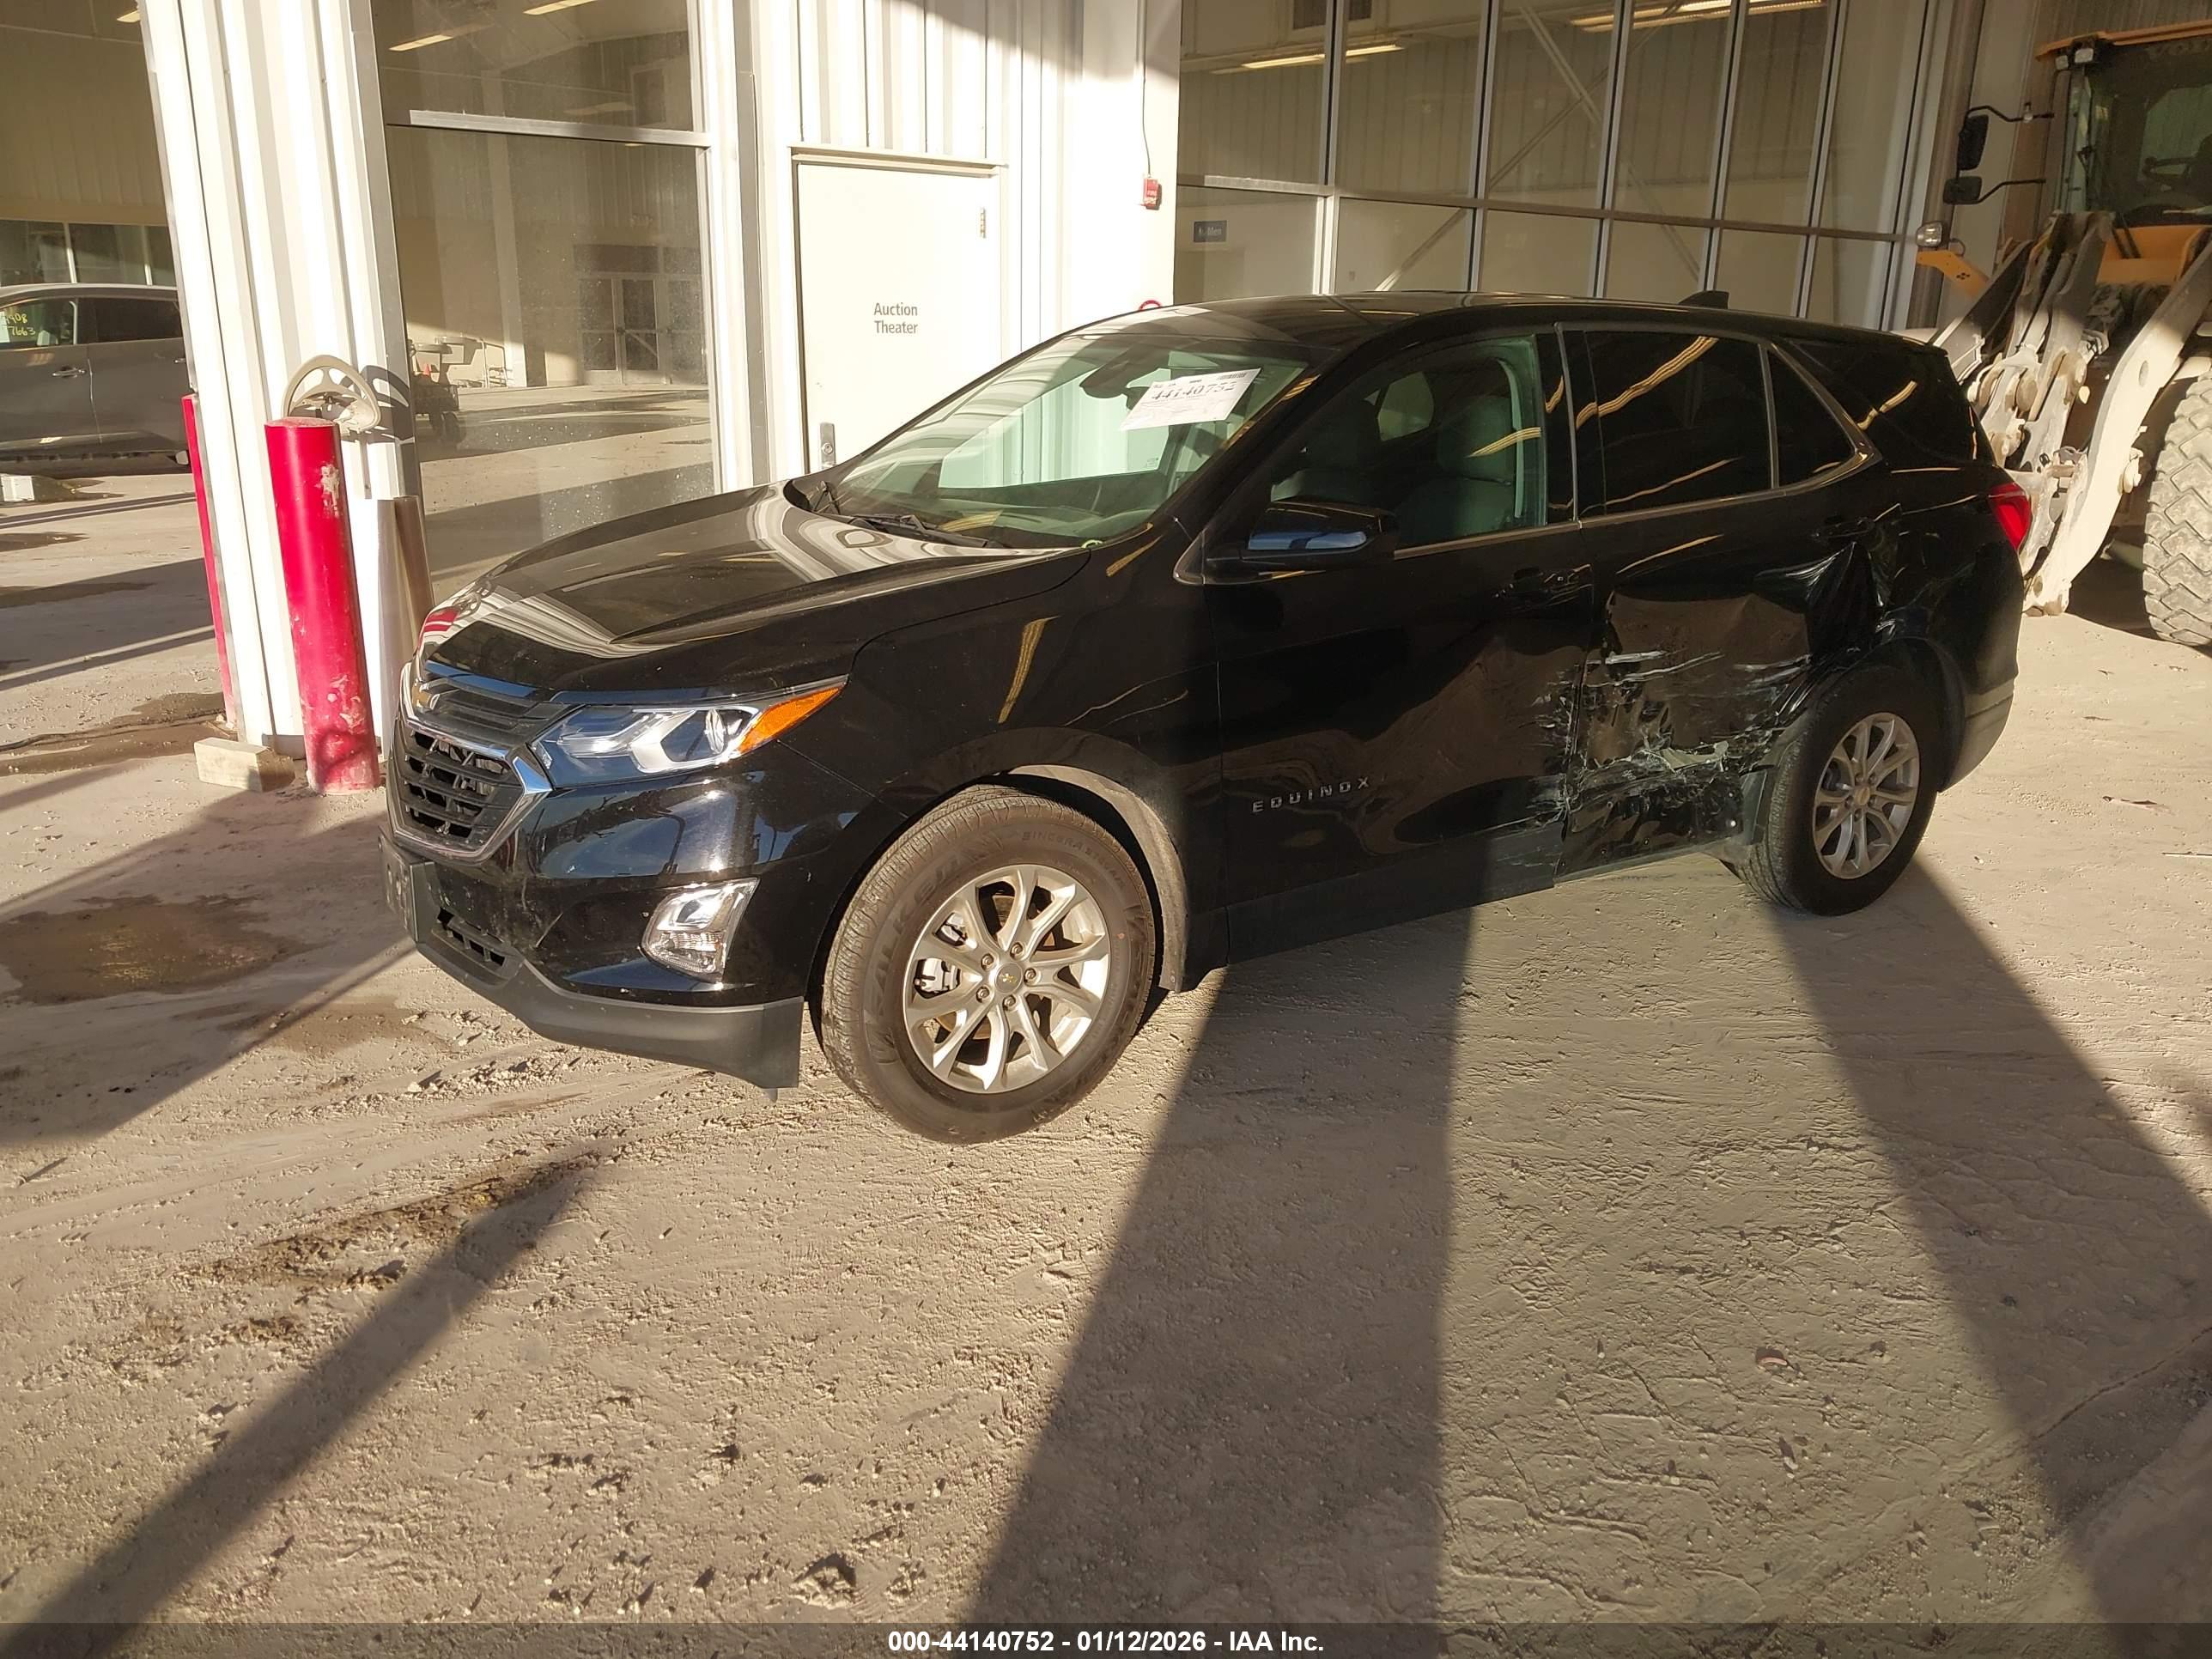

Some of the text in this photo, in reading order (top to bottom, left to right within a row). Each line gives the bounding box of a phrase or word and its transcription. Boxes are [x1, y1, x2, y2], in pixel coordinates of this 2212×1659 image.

[873, 301, 918, 316] Auction
[7, 325, 36, 336] 7663
[873, 319, 918, 334] Theater
[1152, 381, 1238, 400] 44140752
[1252, 776, 1370, 813] EQUINOX
